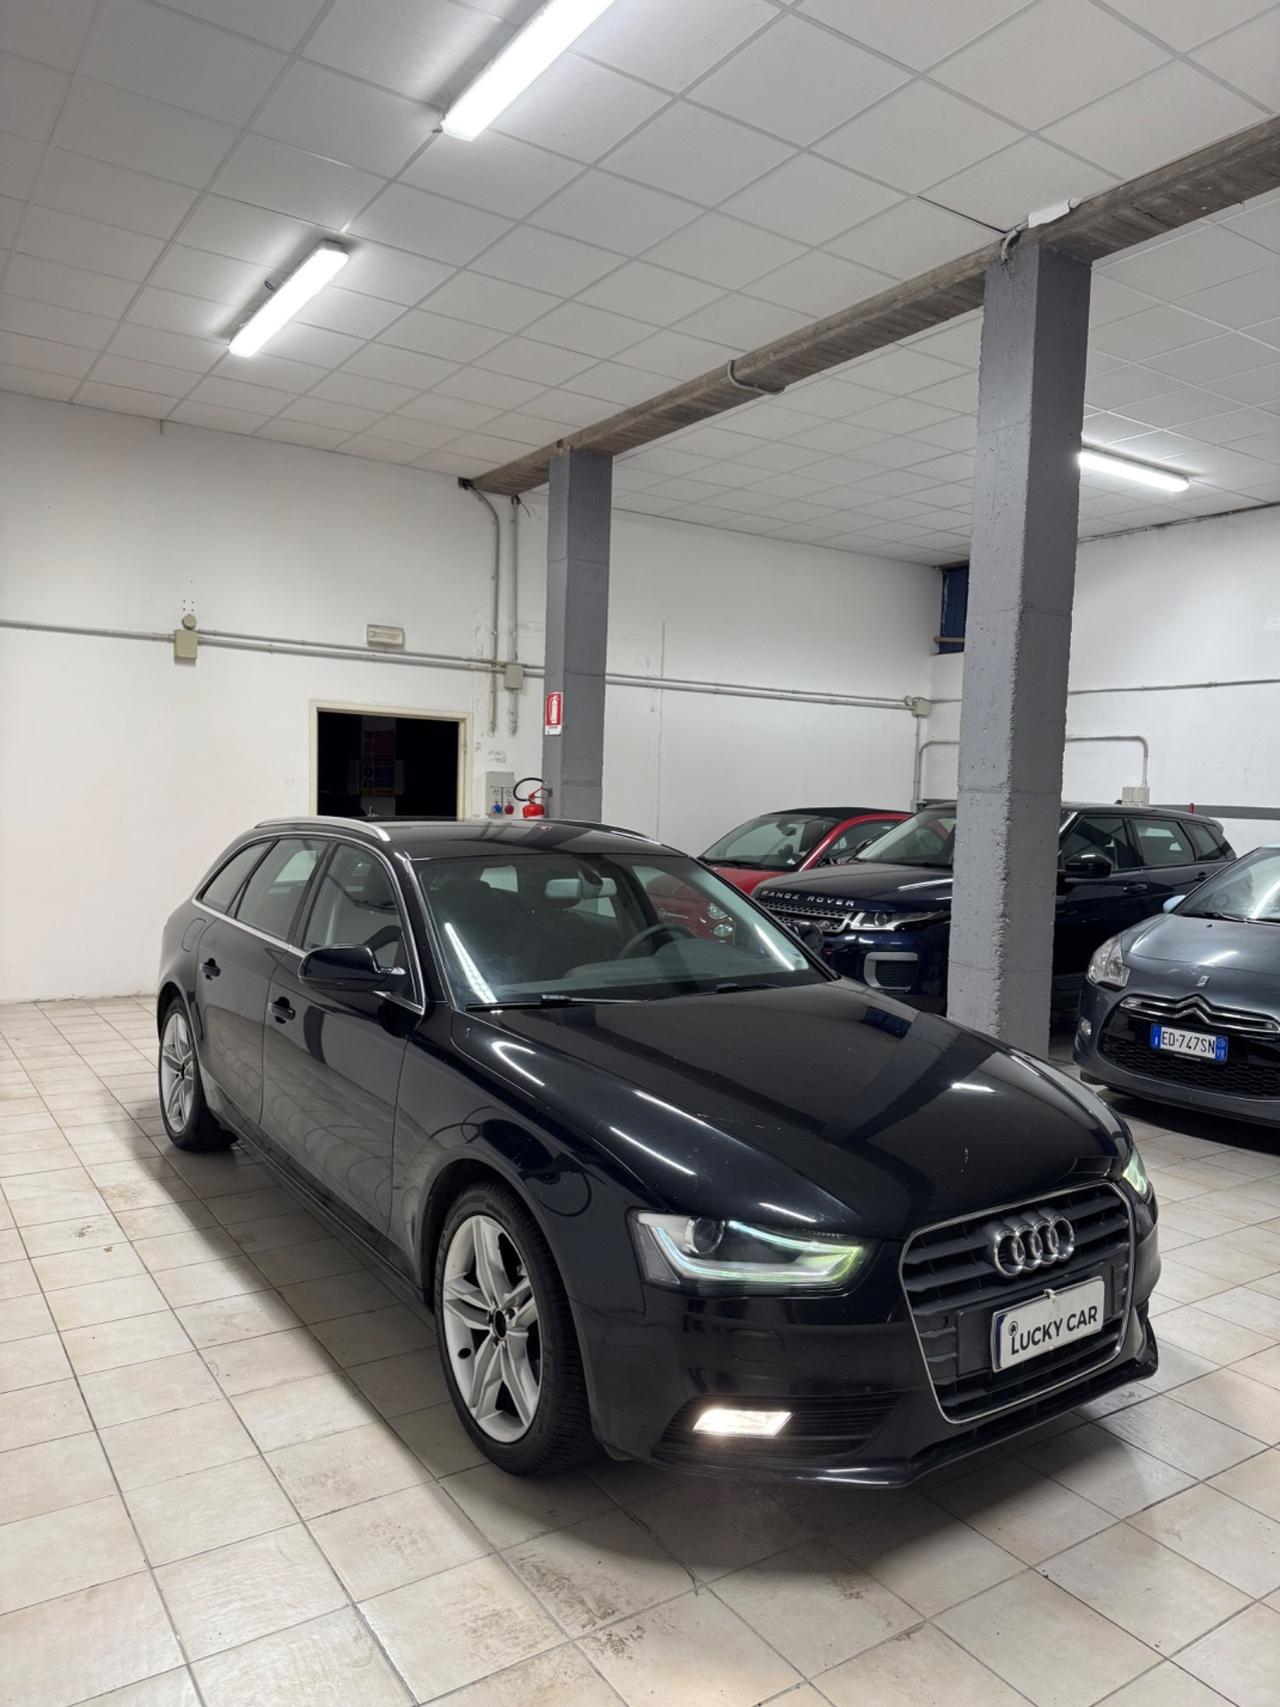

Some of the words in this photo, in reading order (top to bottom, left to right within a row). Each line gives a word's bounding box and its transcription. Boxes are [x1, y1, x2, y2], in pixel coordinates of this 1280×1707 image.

[761, 890, 800, 900] RANGE
[807, 896, 855, 906] ROVER
[1009, 1317, 1064, 1356] LUCKY
[1066, 1305, 1099, 1332] CAR
